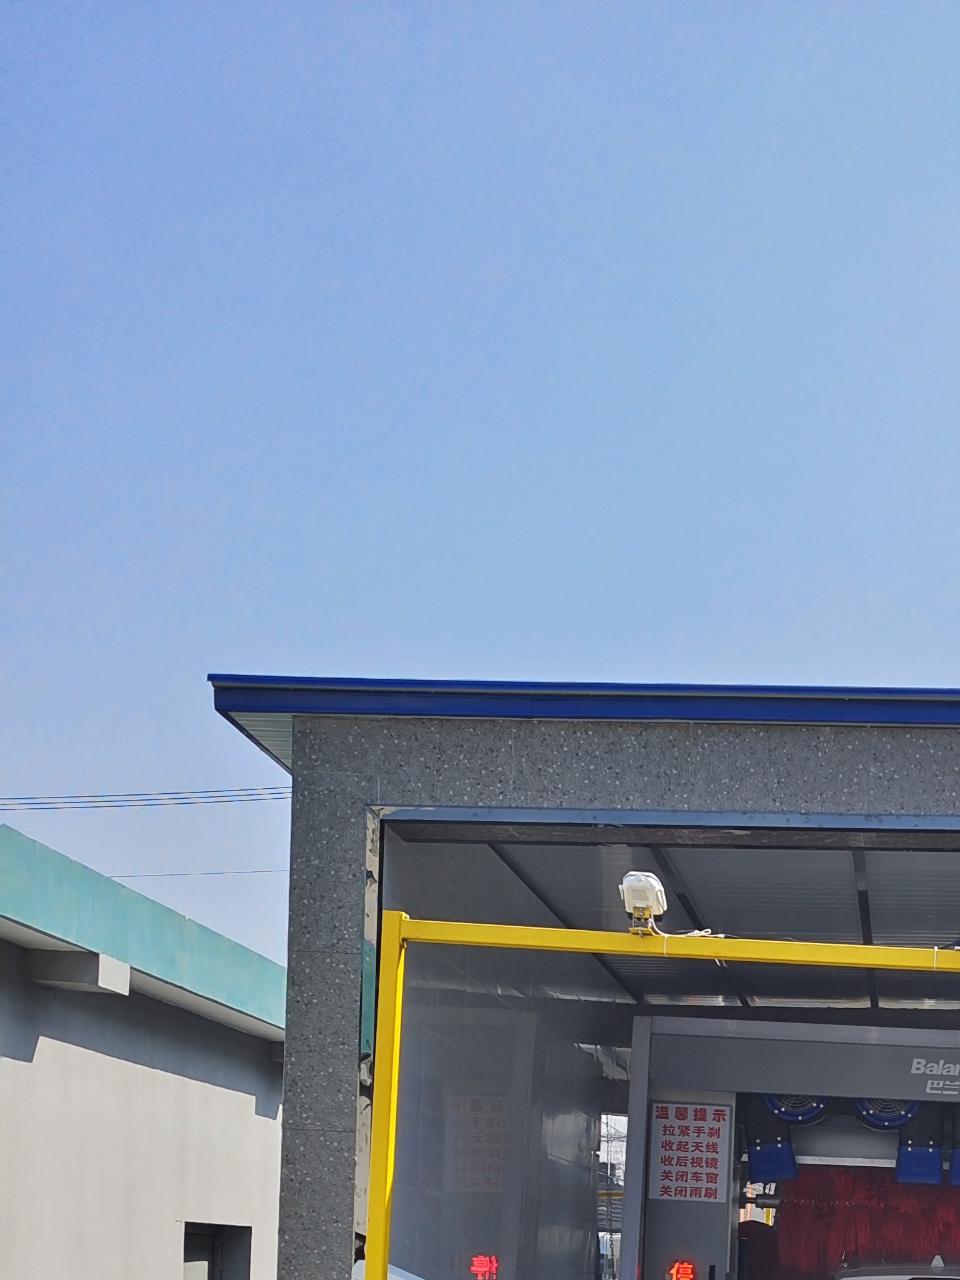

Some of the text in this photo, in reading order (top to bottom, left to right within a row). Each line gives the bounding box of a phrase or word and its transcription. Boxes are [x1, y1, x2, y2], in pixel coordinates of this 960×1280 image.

[655, 1105, 727, 1122] 温馨提示
[662, 1124, 721, 1139] 拉紧手刹
[661, 1139, 719, 1154] 收起天线
[660, 1155, 718, 1169] 收后视镜
[660, 1170, 718, 1184] 关闭车窗
[660, 1185, 718, 1200] 关闭雨刷
